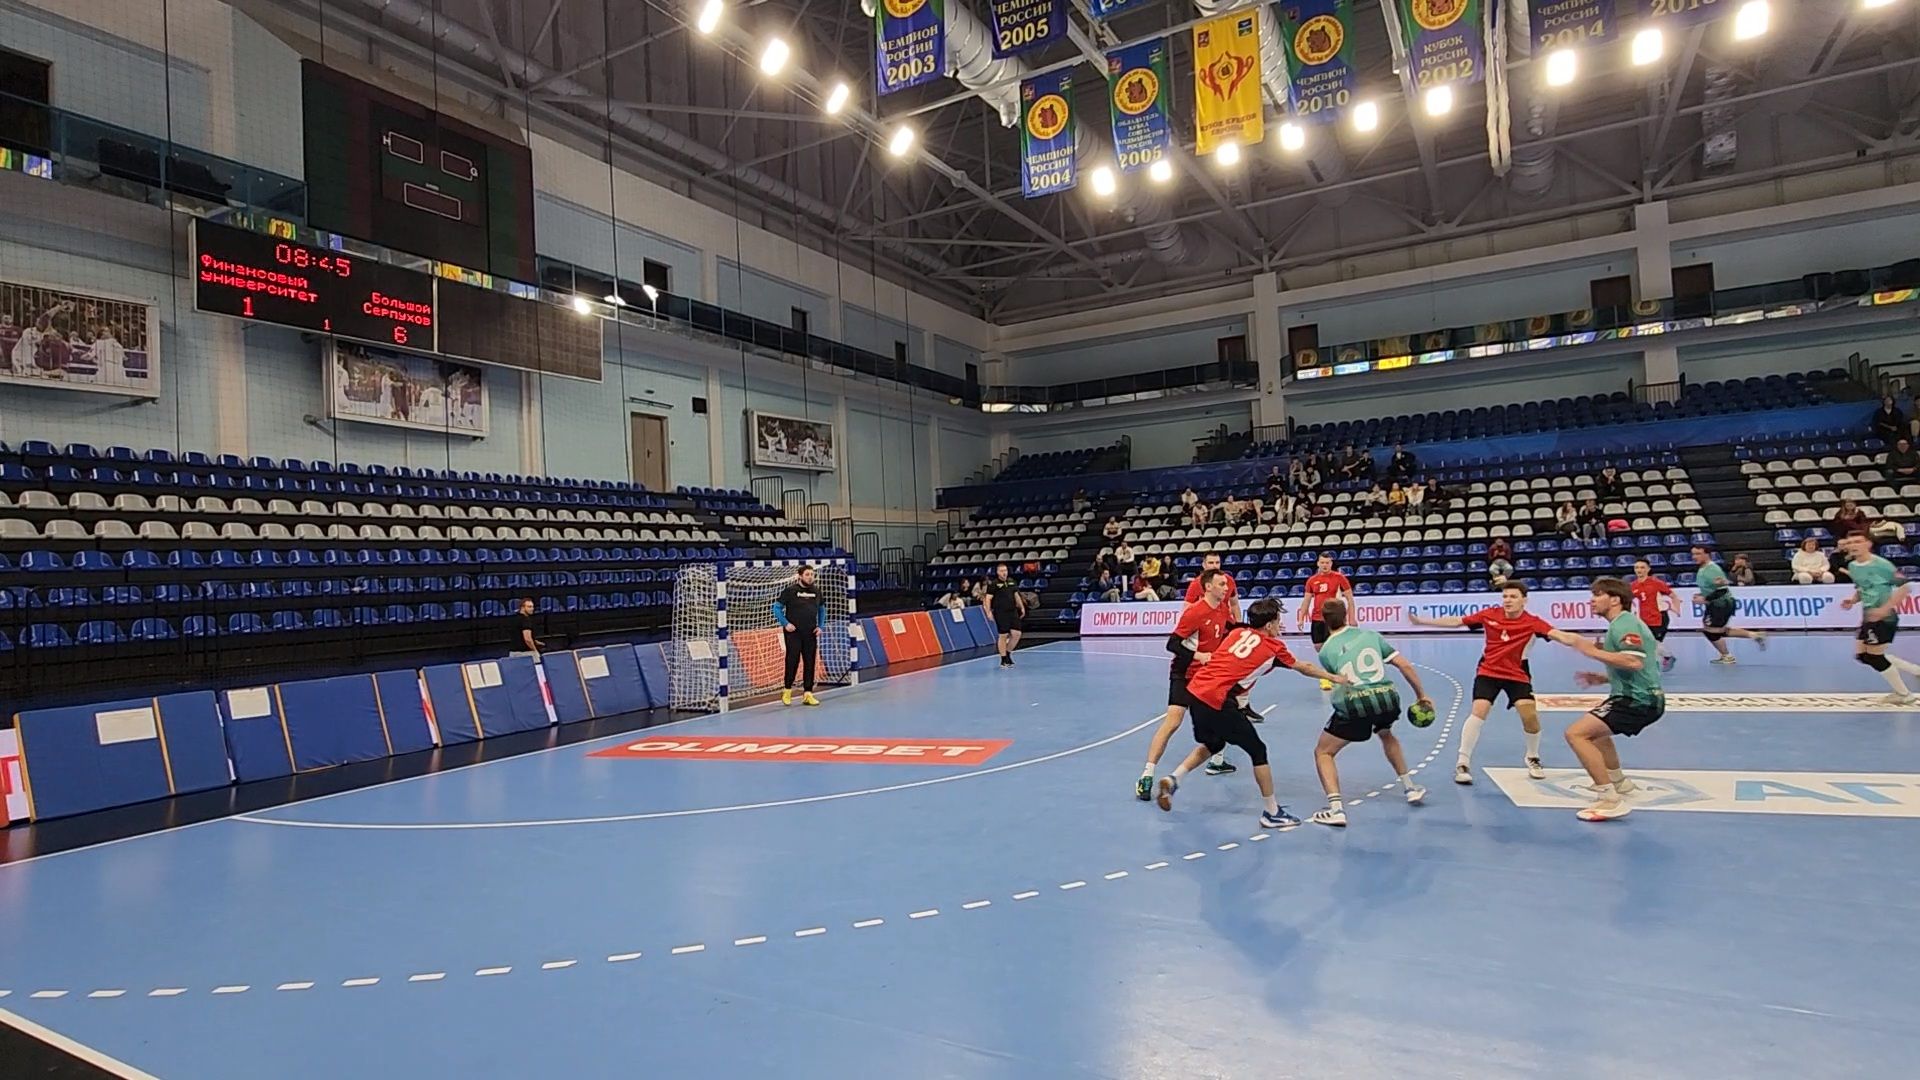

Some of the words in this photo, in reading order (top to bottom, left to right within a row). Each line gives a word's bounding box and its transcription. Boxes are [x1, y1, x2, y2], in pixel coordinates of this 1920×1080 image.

[1000, 2, 1052, 27] РОССИИ
[1544, 6, 1600, 28] РОССИИ
[880, 24, 939, 52] ЧЕМПИОН
[1000, 17, 1049, 51] 2005
[1423, 34, 1464, 54] КУБОК
[1540, 18, 1606, 49] 2014
[886, 40, 934, 64] РОССИИ
[1420, 47, 1469, 67] РОССИИ
[887, 54, 936, 86] 2003
[1296, 66, 1347, 86] ЧЕМПИОН
[1418, 58, 1474, 88] 2012
[1301, 80, 1343, 97] РОССИИ
[1297, 89, 1350, 116] 2010
[1025, 145, 1074, 166] ЧЕМПИОН
[1030, 157, 1070, 175] РОССИИ
[1119, 144, 1162, 171] 2005
[1031, 168, 1071, 192] 2004
[200, 254, 308, 289] Финансовый
[275, 243, 351, 278] 08:45
[242, 296, 254, 316] 1
[363, 302, 432, 326] Серпухов
[371, 291, 431, 315] Большой
[323, 319, 331, 331] 1
[393, 325, 408, 344] 6
[1093, 610, 1138, 627] СМОТРИ
[1142, 609, 1180, 626] СПОРТ
[1357, 605, 1402, 622] СПОРТ
[1214, 624, 1220, 639] 2
[1227, 630, 1261, 659] 18
[1339, 647, 1385, 687] 19
[627, 741, 986, 758] OLIMPBET
